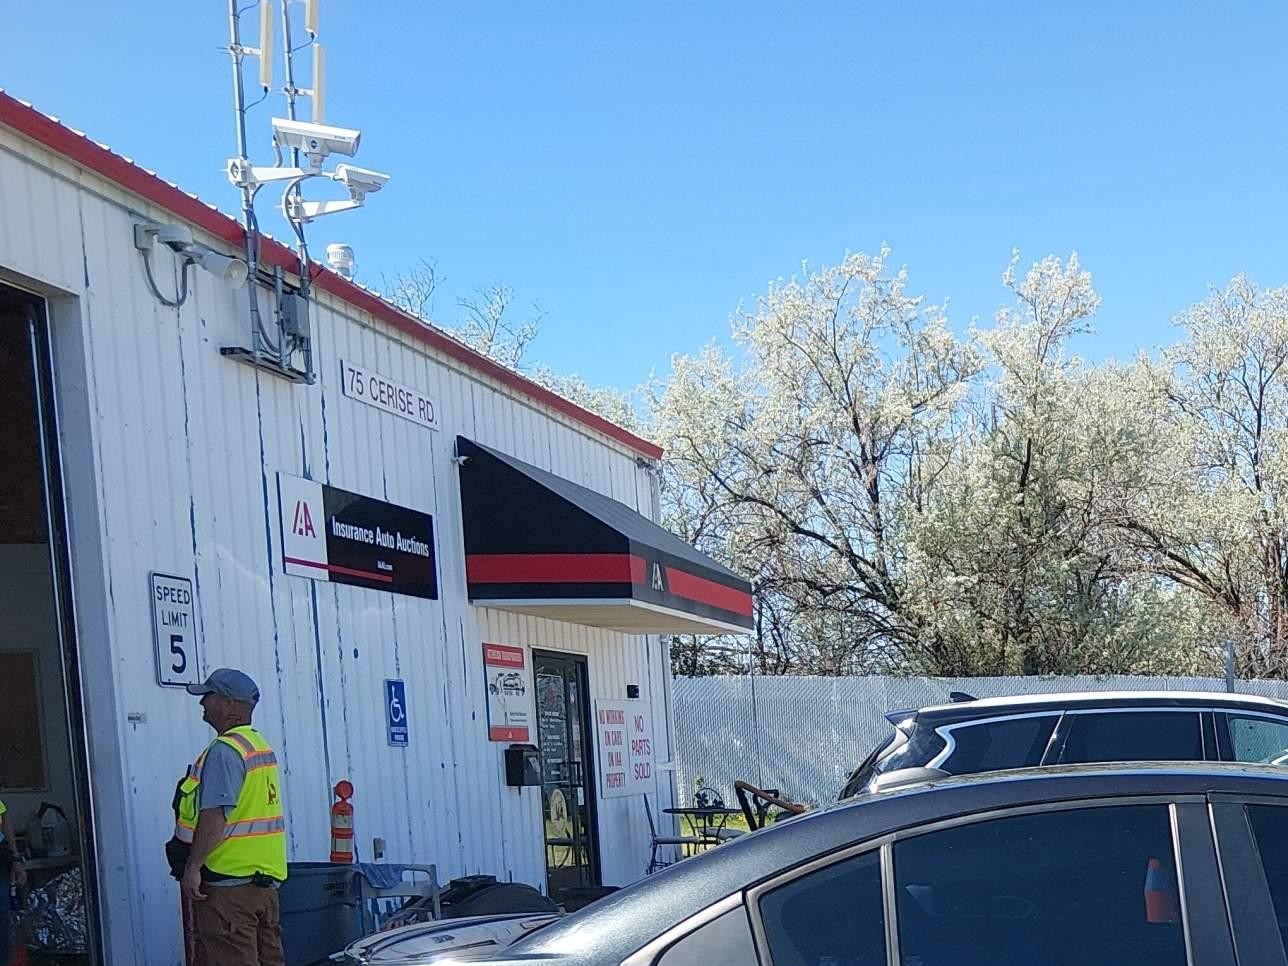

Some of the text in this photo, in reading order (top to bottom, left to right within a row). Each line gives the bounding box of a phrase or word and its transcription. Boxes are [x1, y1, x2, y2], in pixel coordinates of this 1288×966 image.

[348, 367, 438, 425] 75 CERISE RD.
[331, 515, 430, 558] Insurance Auto Auctions
[156, 585, 191, 605] SPEED
[161, 610, 188, 628] LIMIT
[170, 634, 187, 674] 5
[634, 715, 645, 733] NO
[631, 738, 651, 757] PARTS
[634, 762, 651, 780] SOLD
